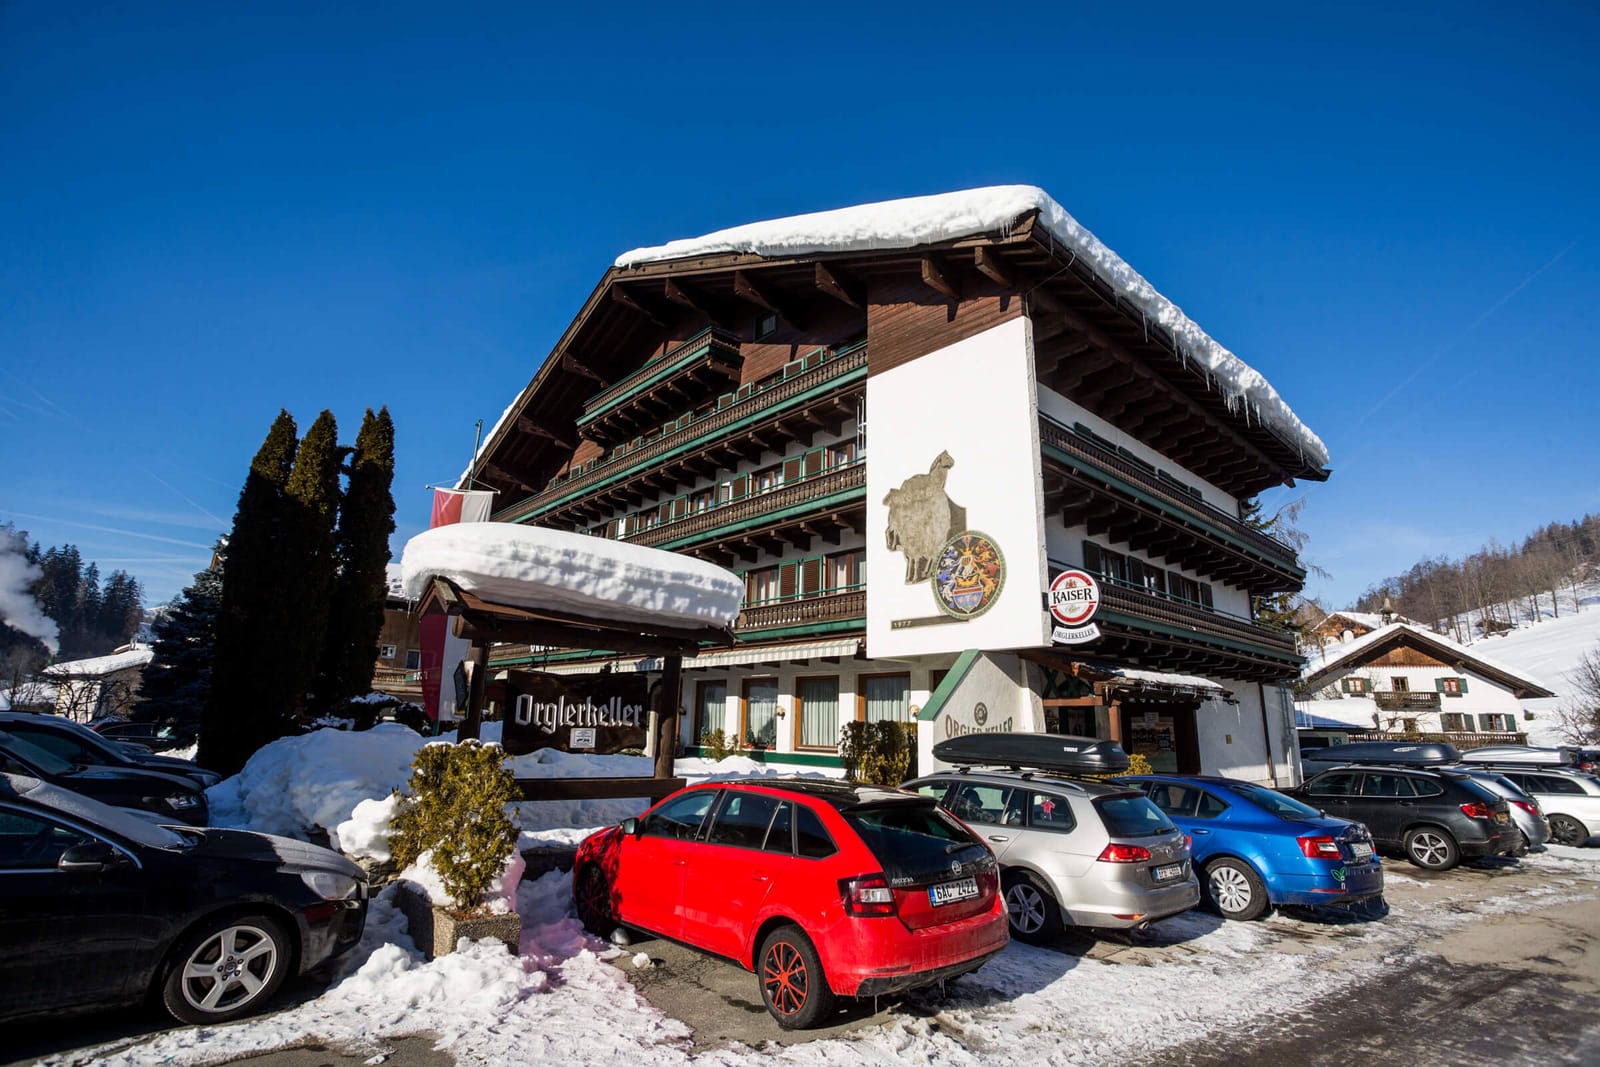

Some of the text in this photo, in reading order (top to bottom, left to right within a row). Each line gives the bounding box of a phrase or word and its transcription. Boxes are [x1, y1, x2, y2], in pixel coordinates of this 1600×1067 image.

[1053, 588, 1092, 605] KAISER
[515, 693, 643, 735] Orglerkeller
[936, 880, 976, 900] 6AC 2422
